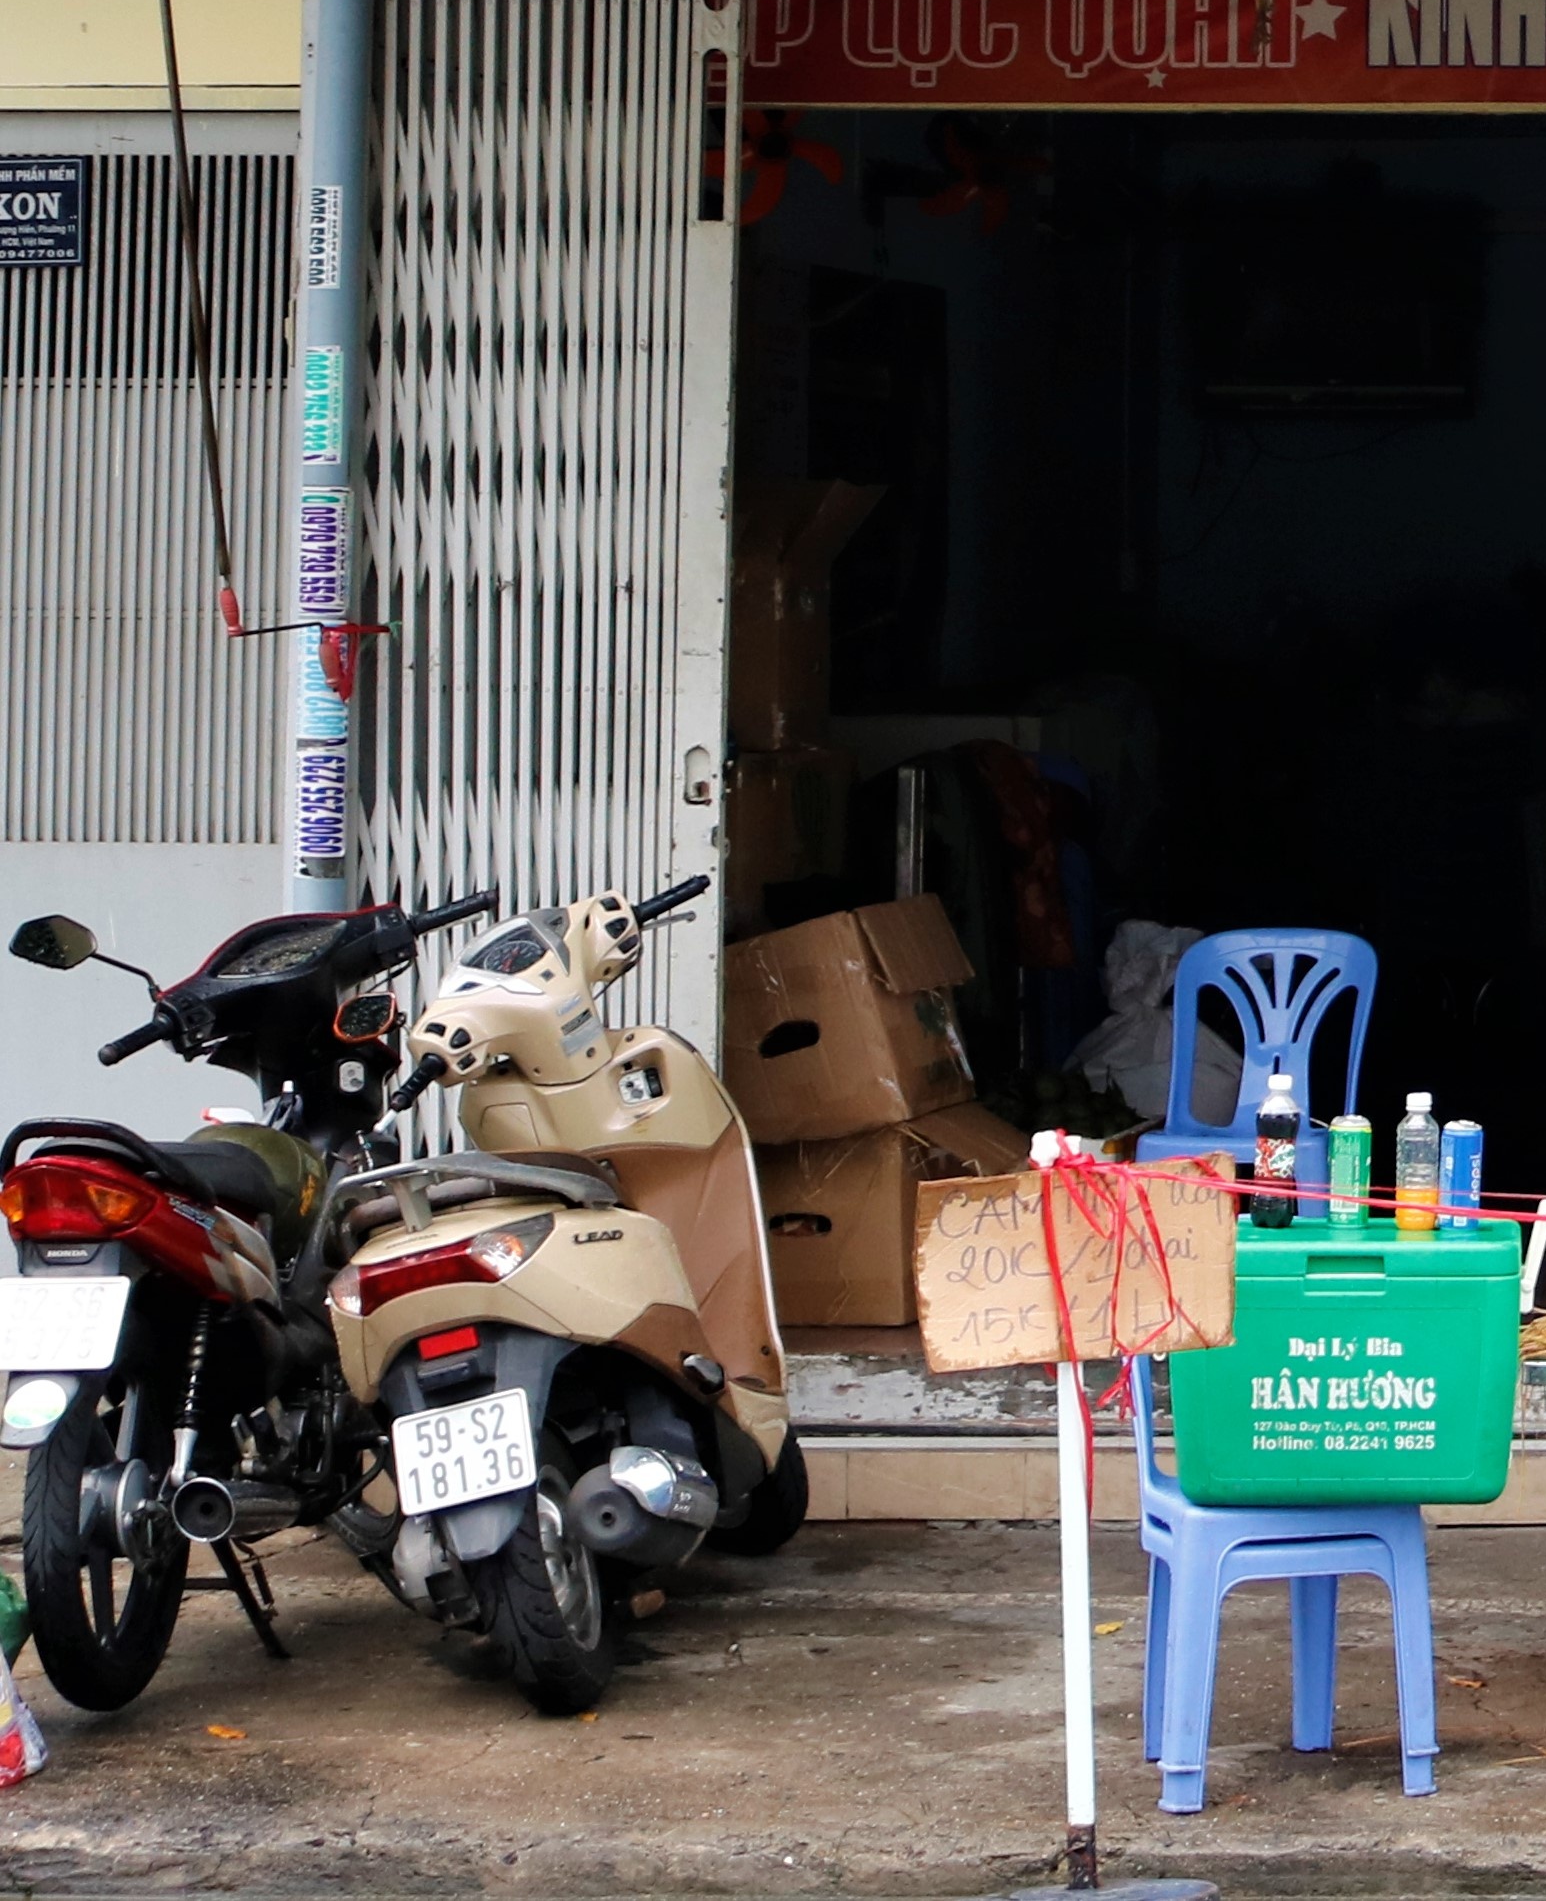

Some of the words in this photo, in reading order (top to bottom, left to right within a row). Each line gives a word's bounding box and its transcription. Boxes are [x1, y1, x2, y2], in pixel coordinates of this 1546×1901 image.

[301, 507, 337, 542] 0979
[300, 546, 337, 572] 739
[301, 755, 346, 783] 229
[301, 786, 344, 814] 255
[300, 816, 343, 854] 0906
[574, 1229, 624, 1244] LEAD
[1366, 1337, 1403, 1356] Bia
[1251, 1367, 1320, 1409] HÂN
[1327, 1369, 1436, 1410] HƯƠNG
[415, 1403, 507, 1458] 59-S2
[1394, 1435, 1435, 1450] 9625
[408, 1443, 525, 1504] 181.36
